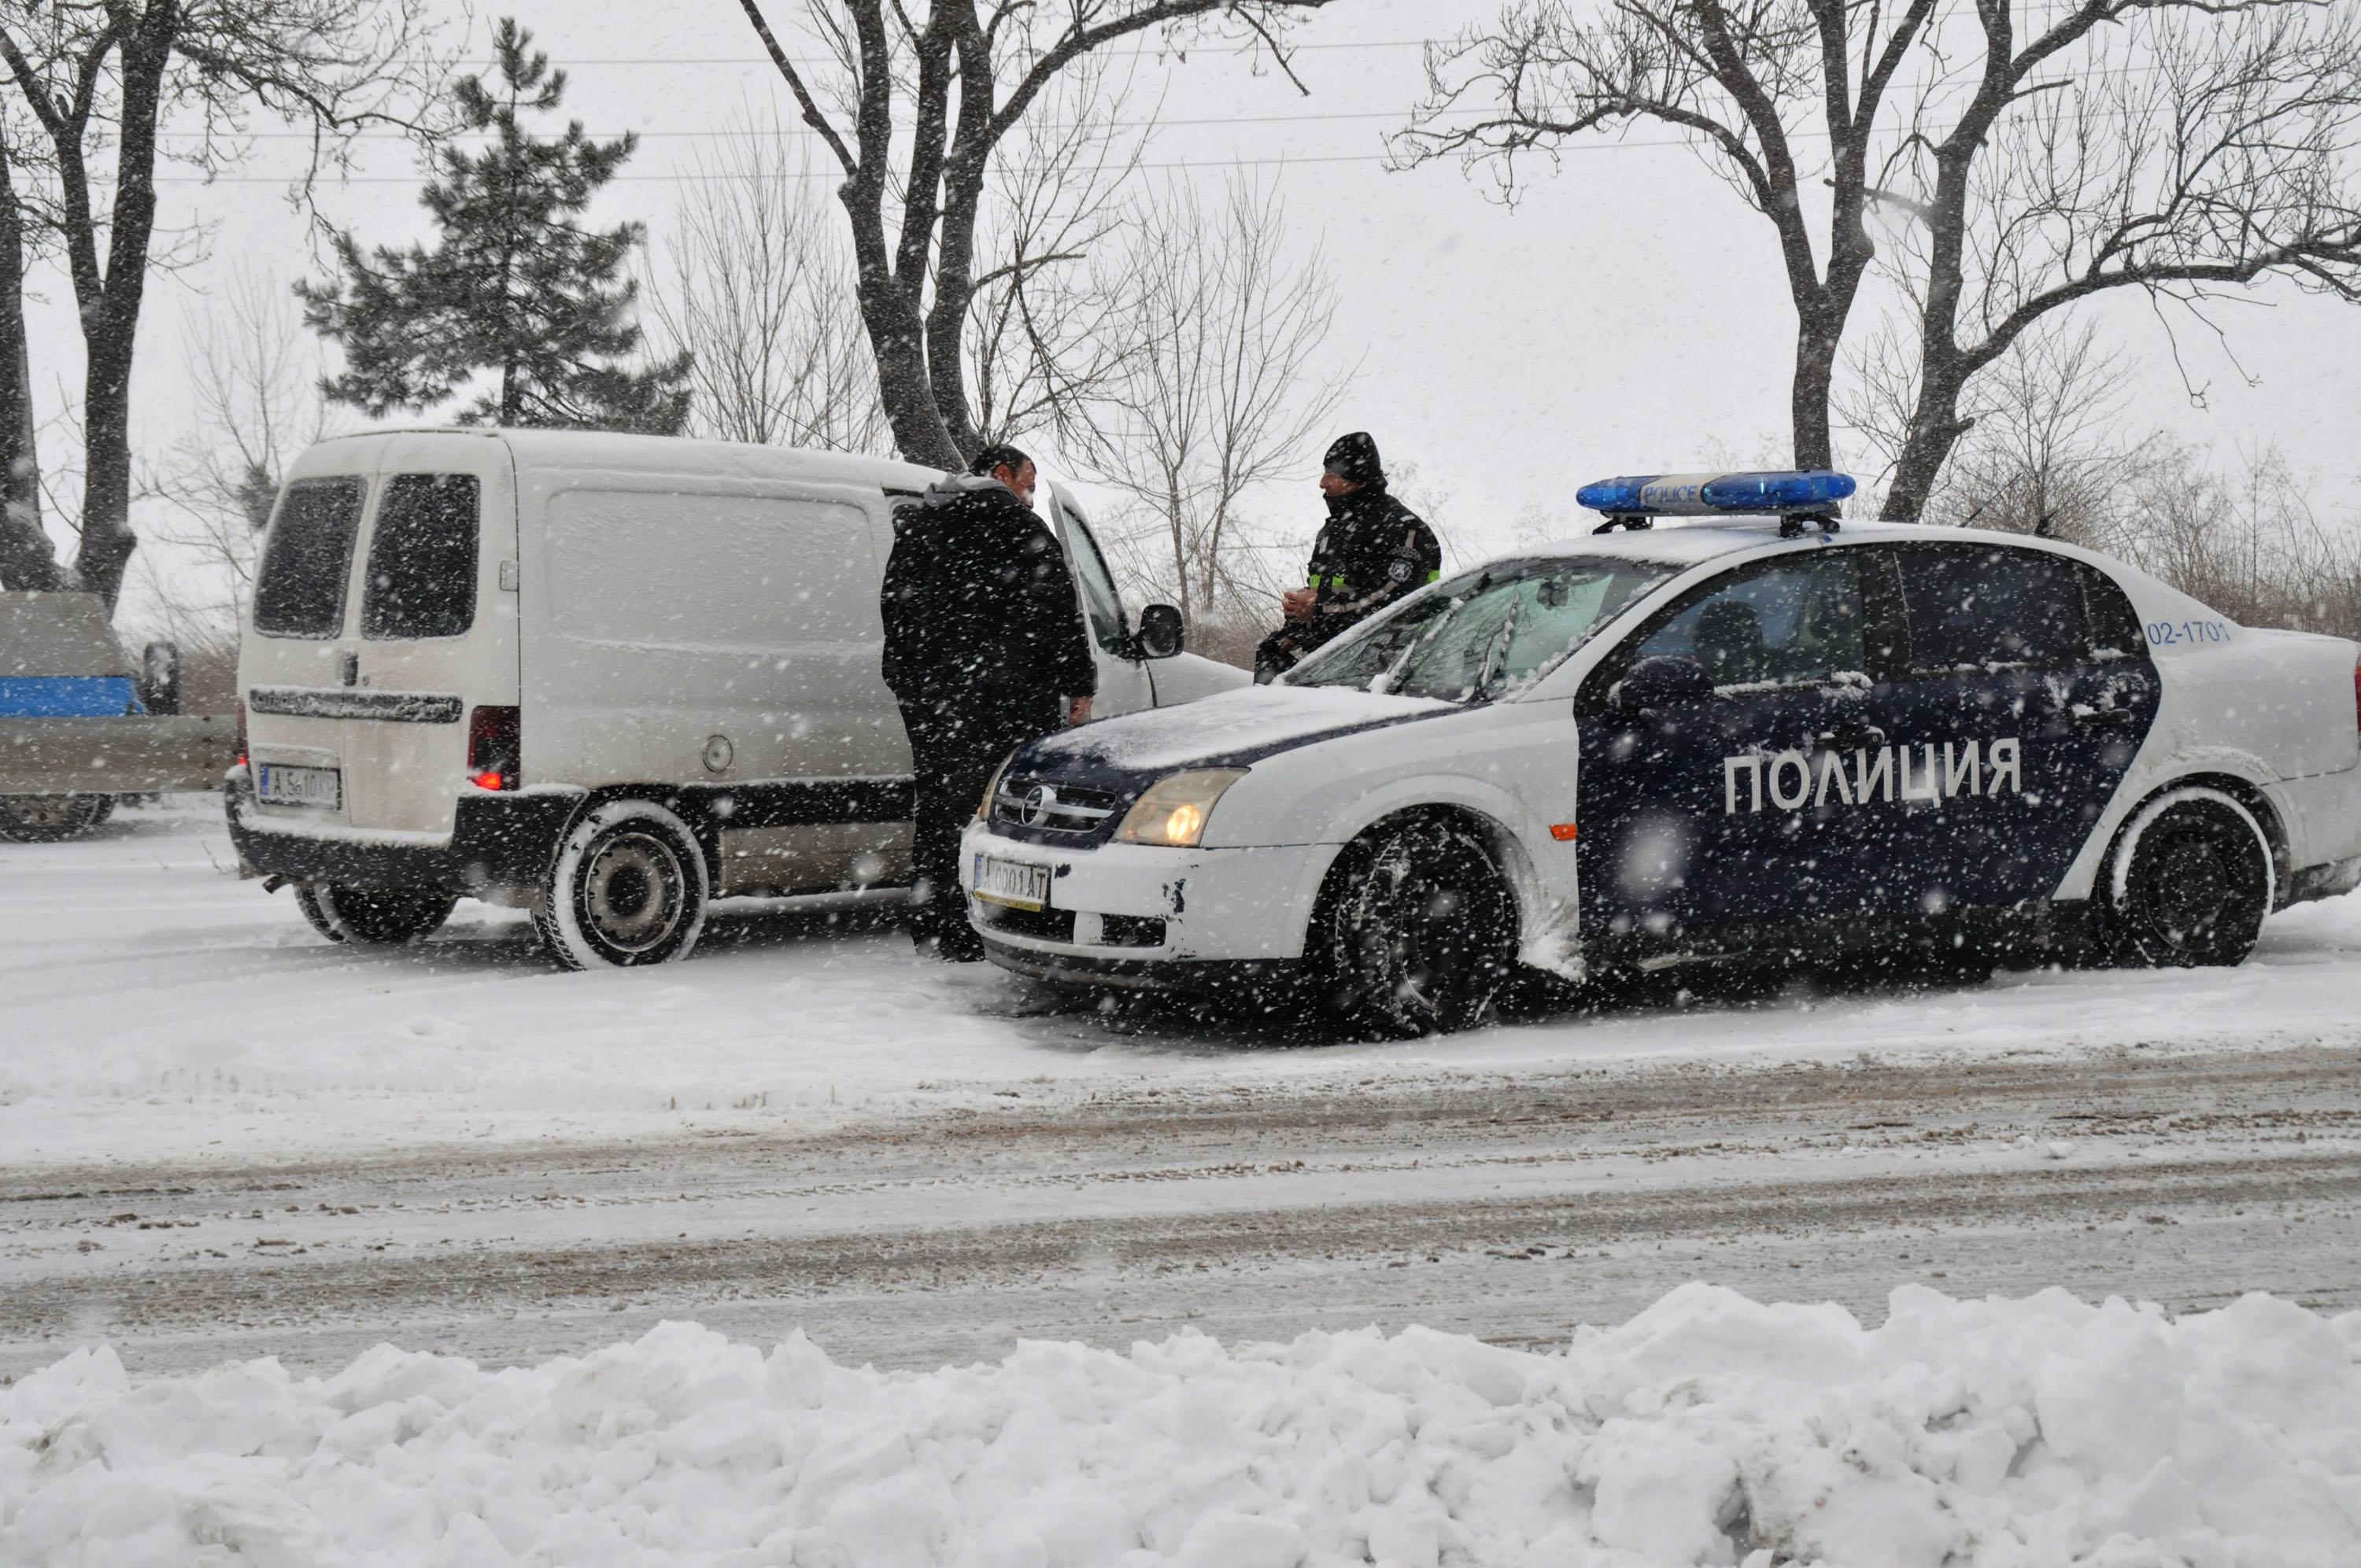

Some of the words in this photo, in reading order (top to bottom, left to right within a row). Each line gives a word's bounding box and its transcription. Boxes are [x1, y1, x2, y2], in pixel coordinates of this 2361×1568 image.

[1644, 485, 1698, 504] POLICE
[2147, 620, 2230, 645] 02-1701
[1724, 737, 2021, 814] ПОЛИЦИЯ
